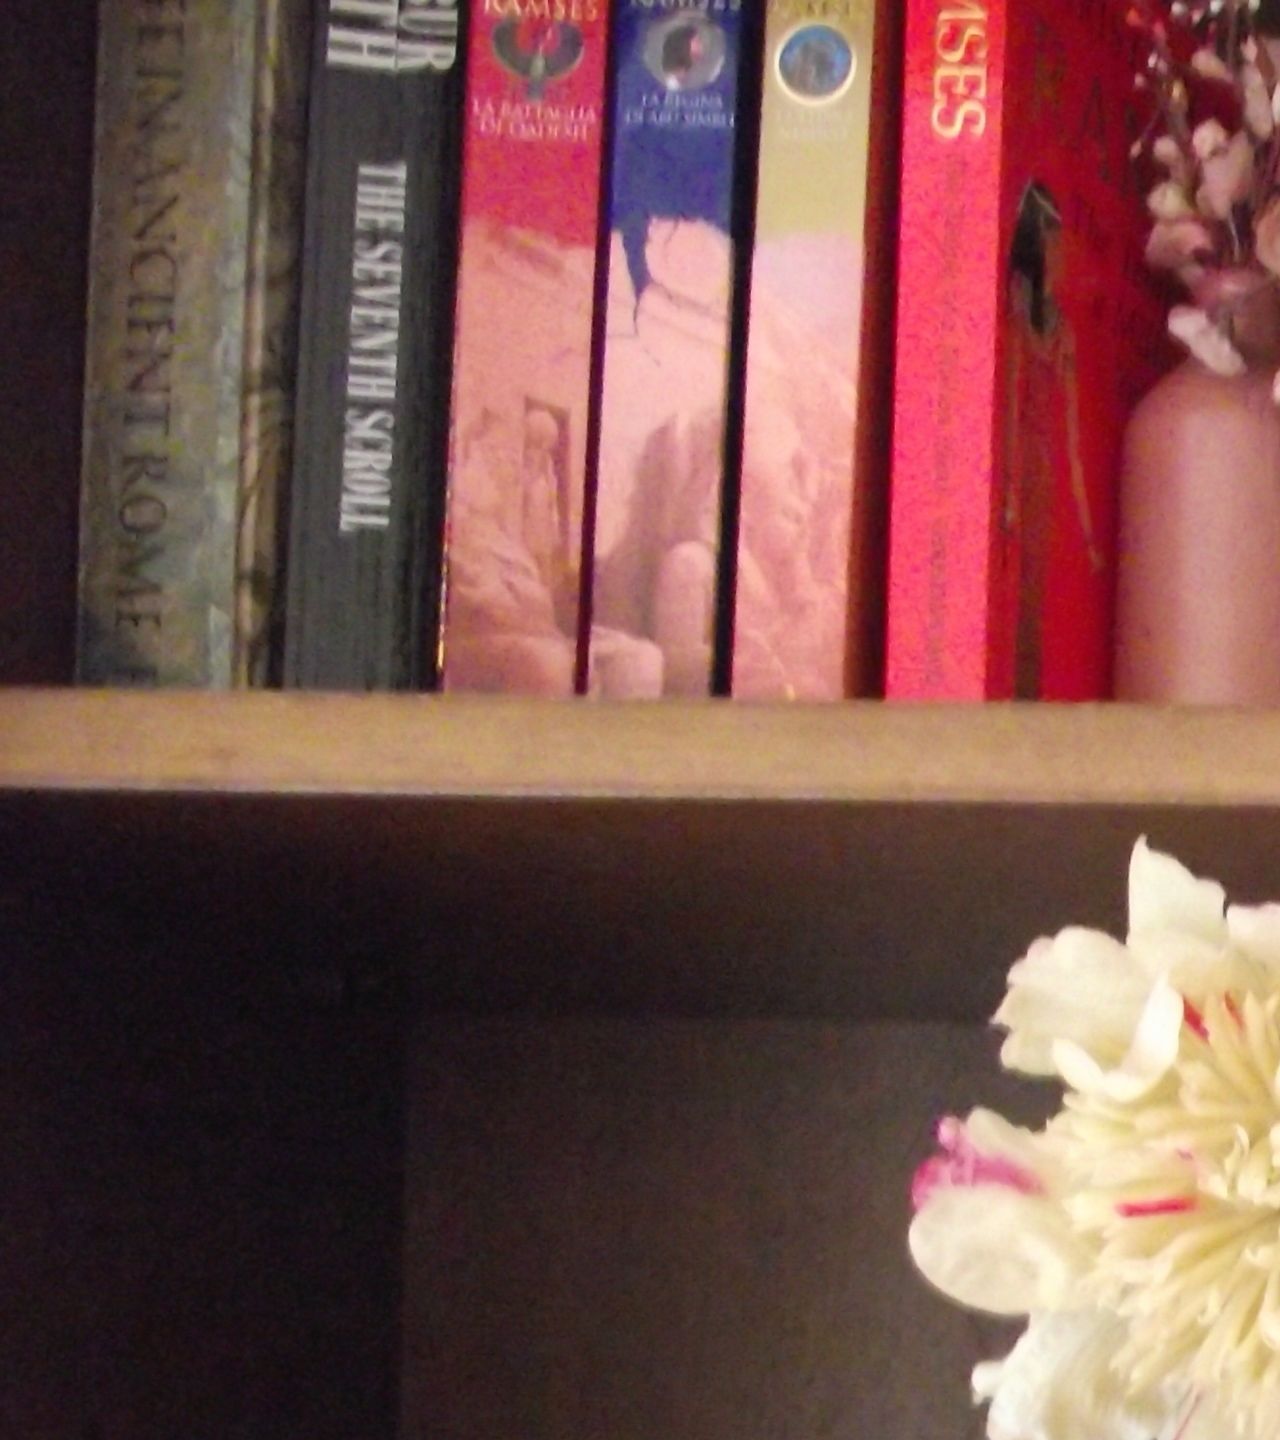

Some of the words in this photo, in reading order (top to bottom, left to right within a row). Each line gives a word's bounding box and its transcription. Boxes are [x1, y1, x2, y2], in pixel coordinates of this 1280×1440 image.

[355, 161, 407, 233] THE
[122, 144, 184, 436] ANCIENT
[346, 238, 404, 399] SEVENTH
[114, 452, 168, 628] ROME
[338, 408, 395, 533] SCROLL
